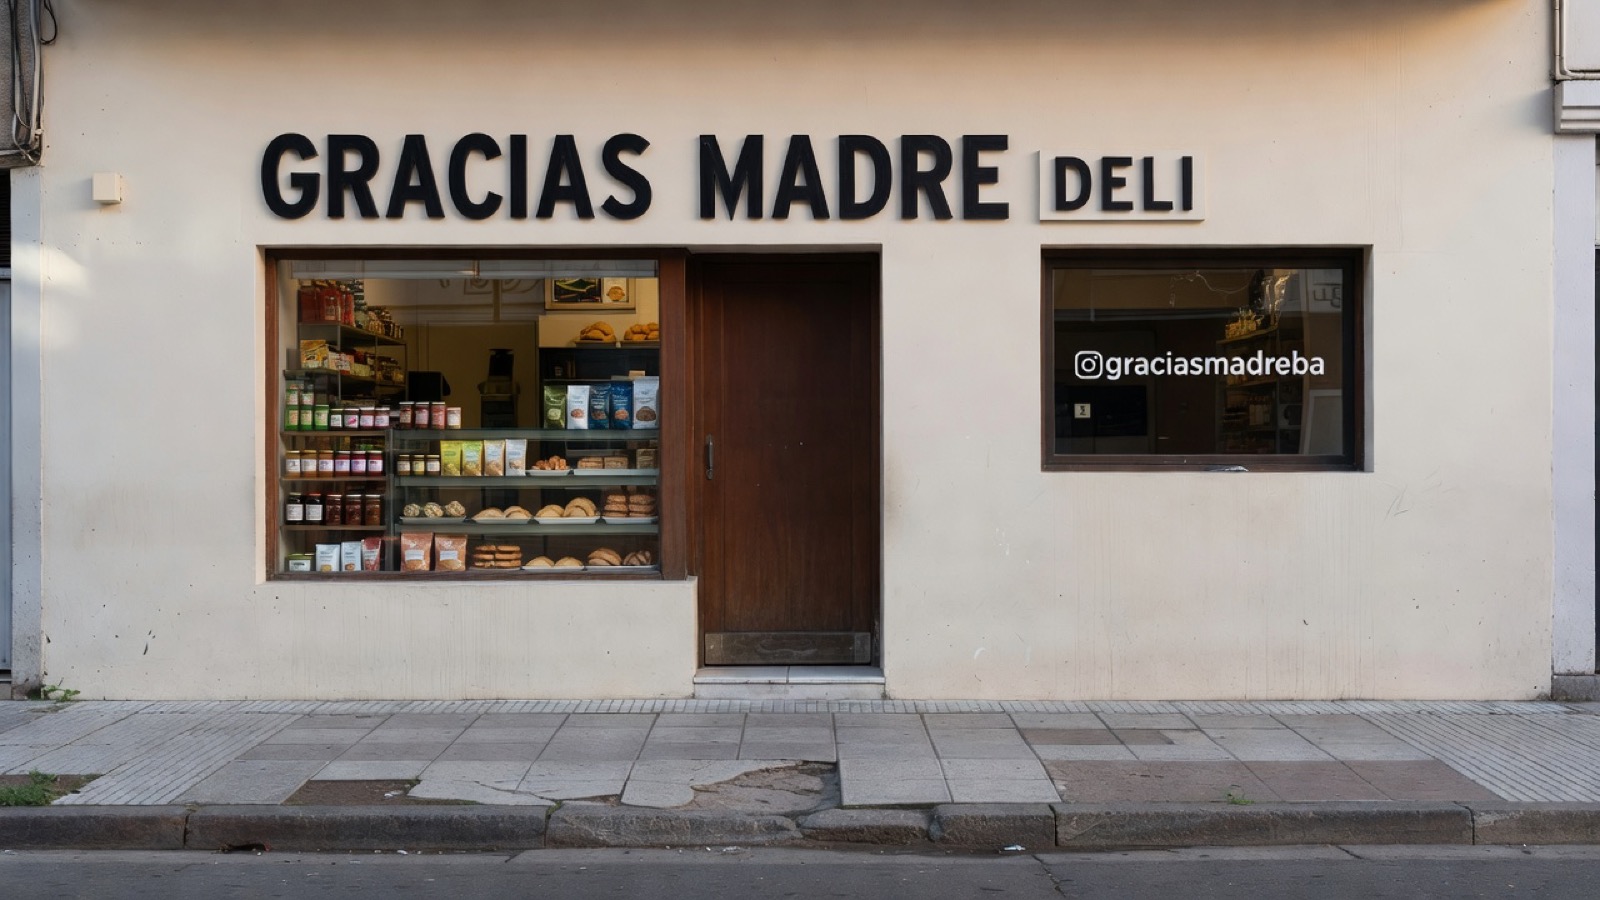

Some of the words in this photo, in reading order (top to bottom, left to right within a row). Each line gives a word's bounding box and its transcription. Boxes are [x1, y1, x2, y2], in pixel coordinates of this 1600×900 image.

[261, 133, 652, 220] GRACIAS
[699, 134, 1009, 220] MADRE
[1055, 156, 1193, 211] DELI
[1105, 349, 1325, 381] graciasmadreba
